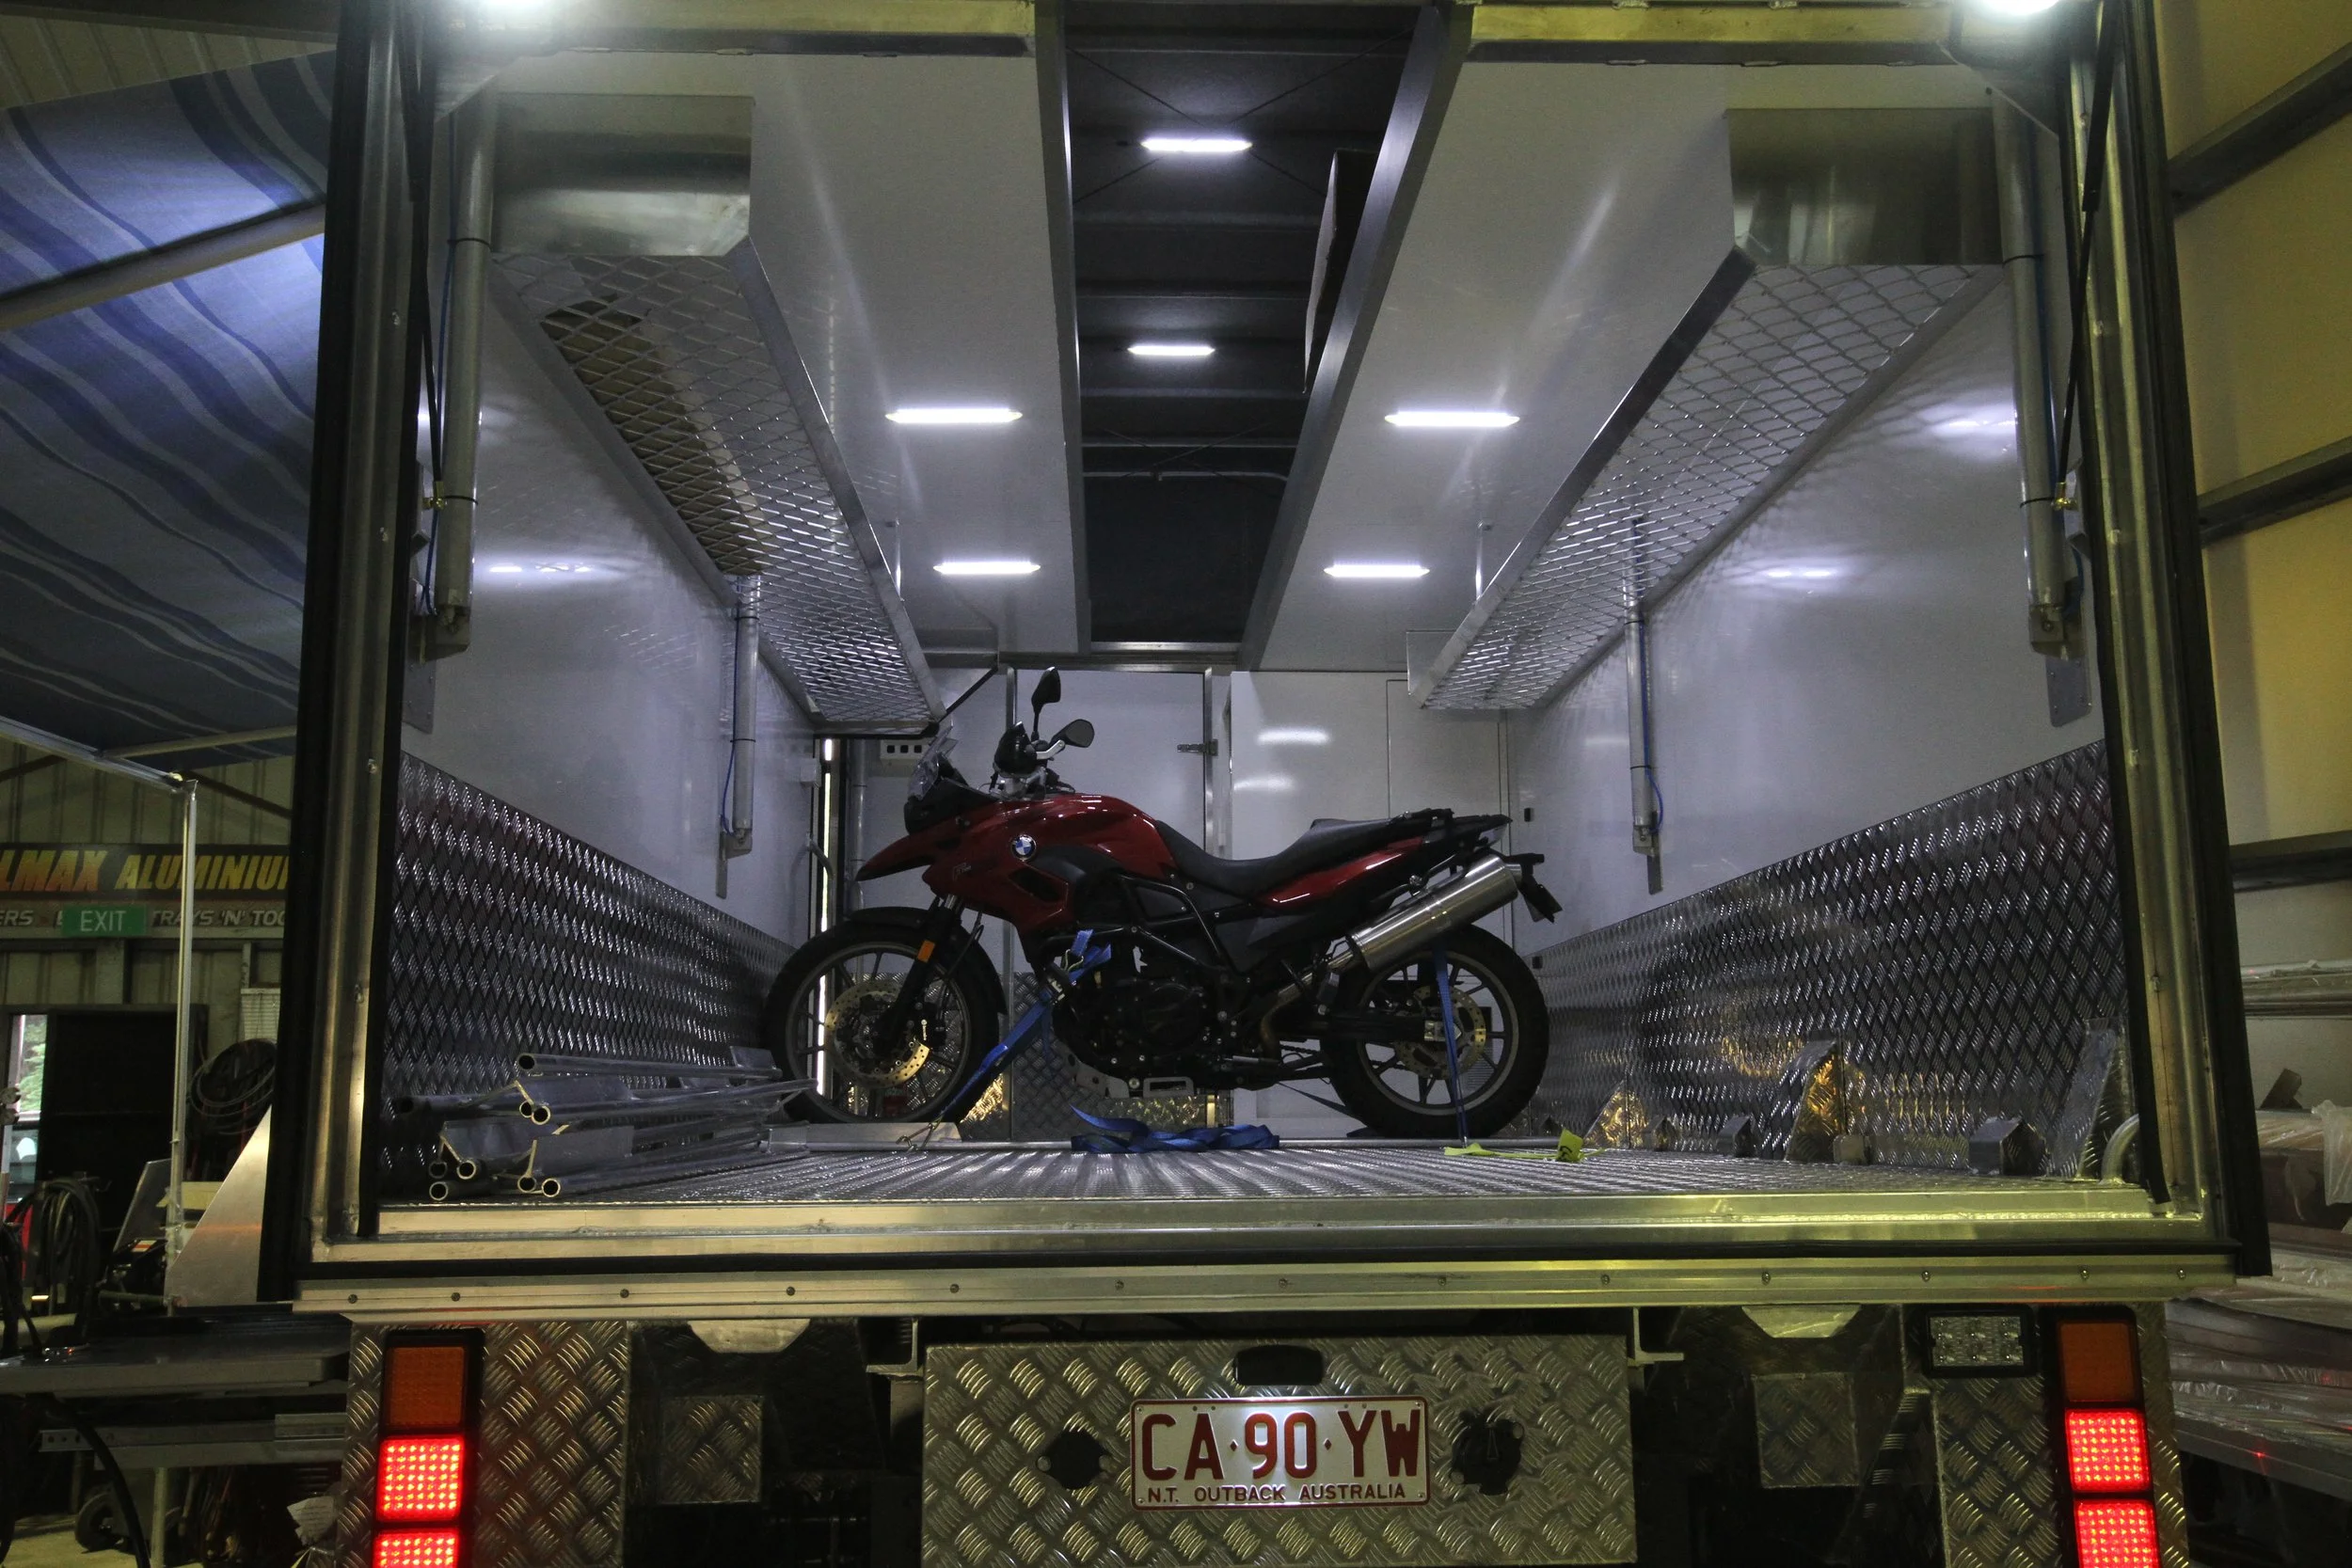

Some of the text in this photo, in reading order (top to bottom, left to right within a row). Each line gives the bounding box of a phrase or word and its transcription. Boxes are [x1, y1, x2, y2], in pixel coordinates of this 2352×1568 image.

[80, 910, 127, 932] EXIT
[1148, 1483, 1406, 1503] N.T. OUTBACK AUSTRALIA
